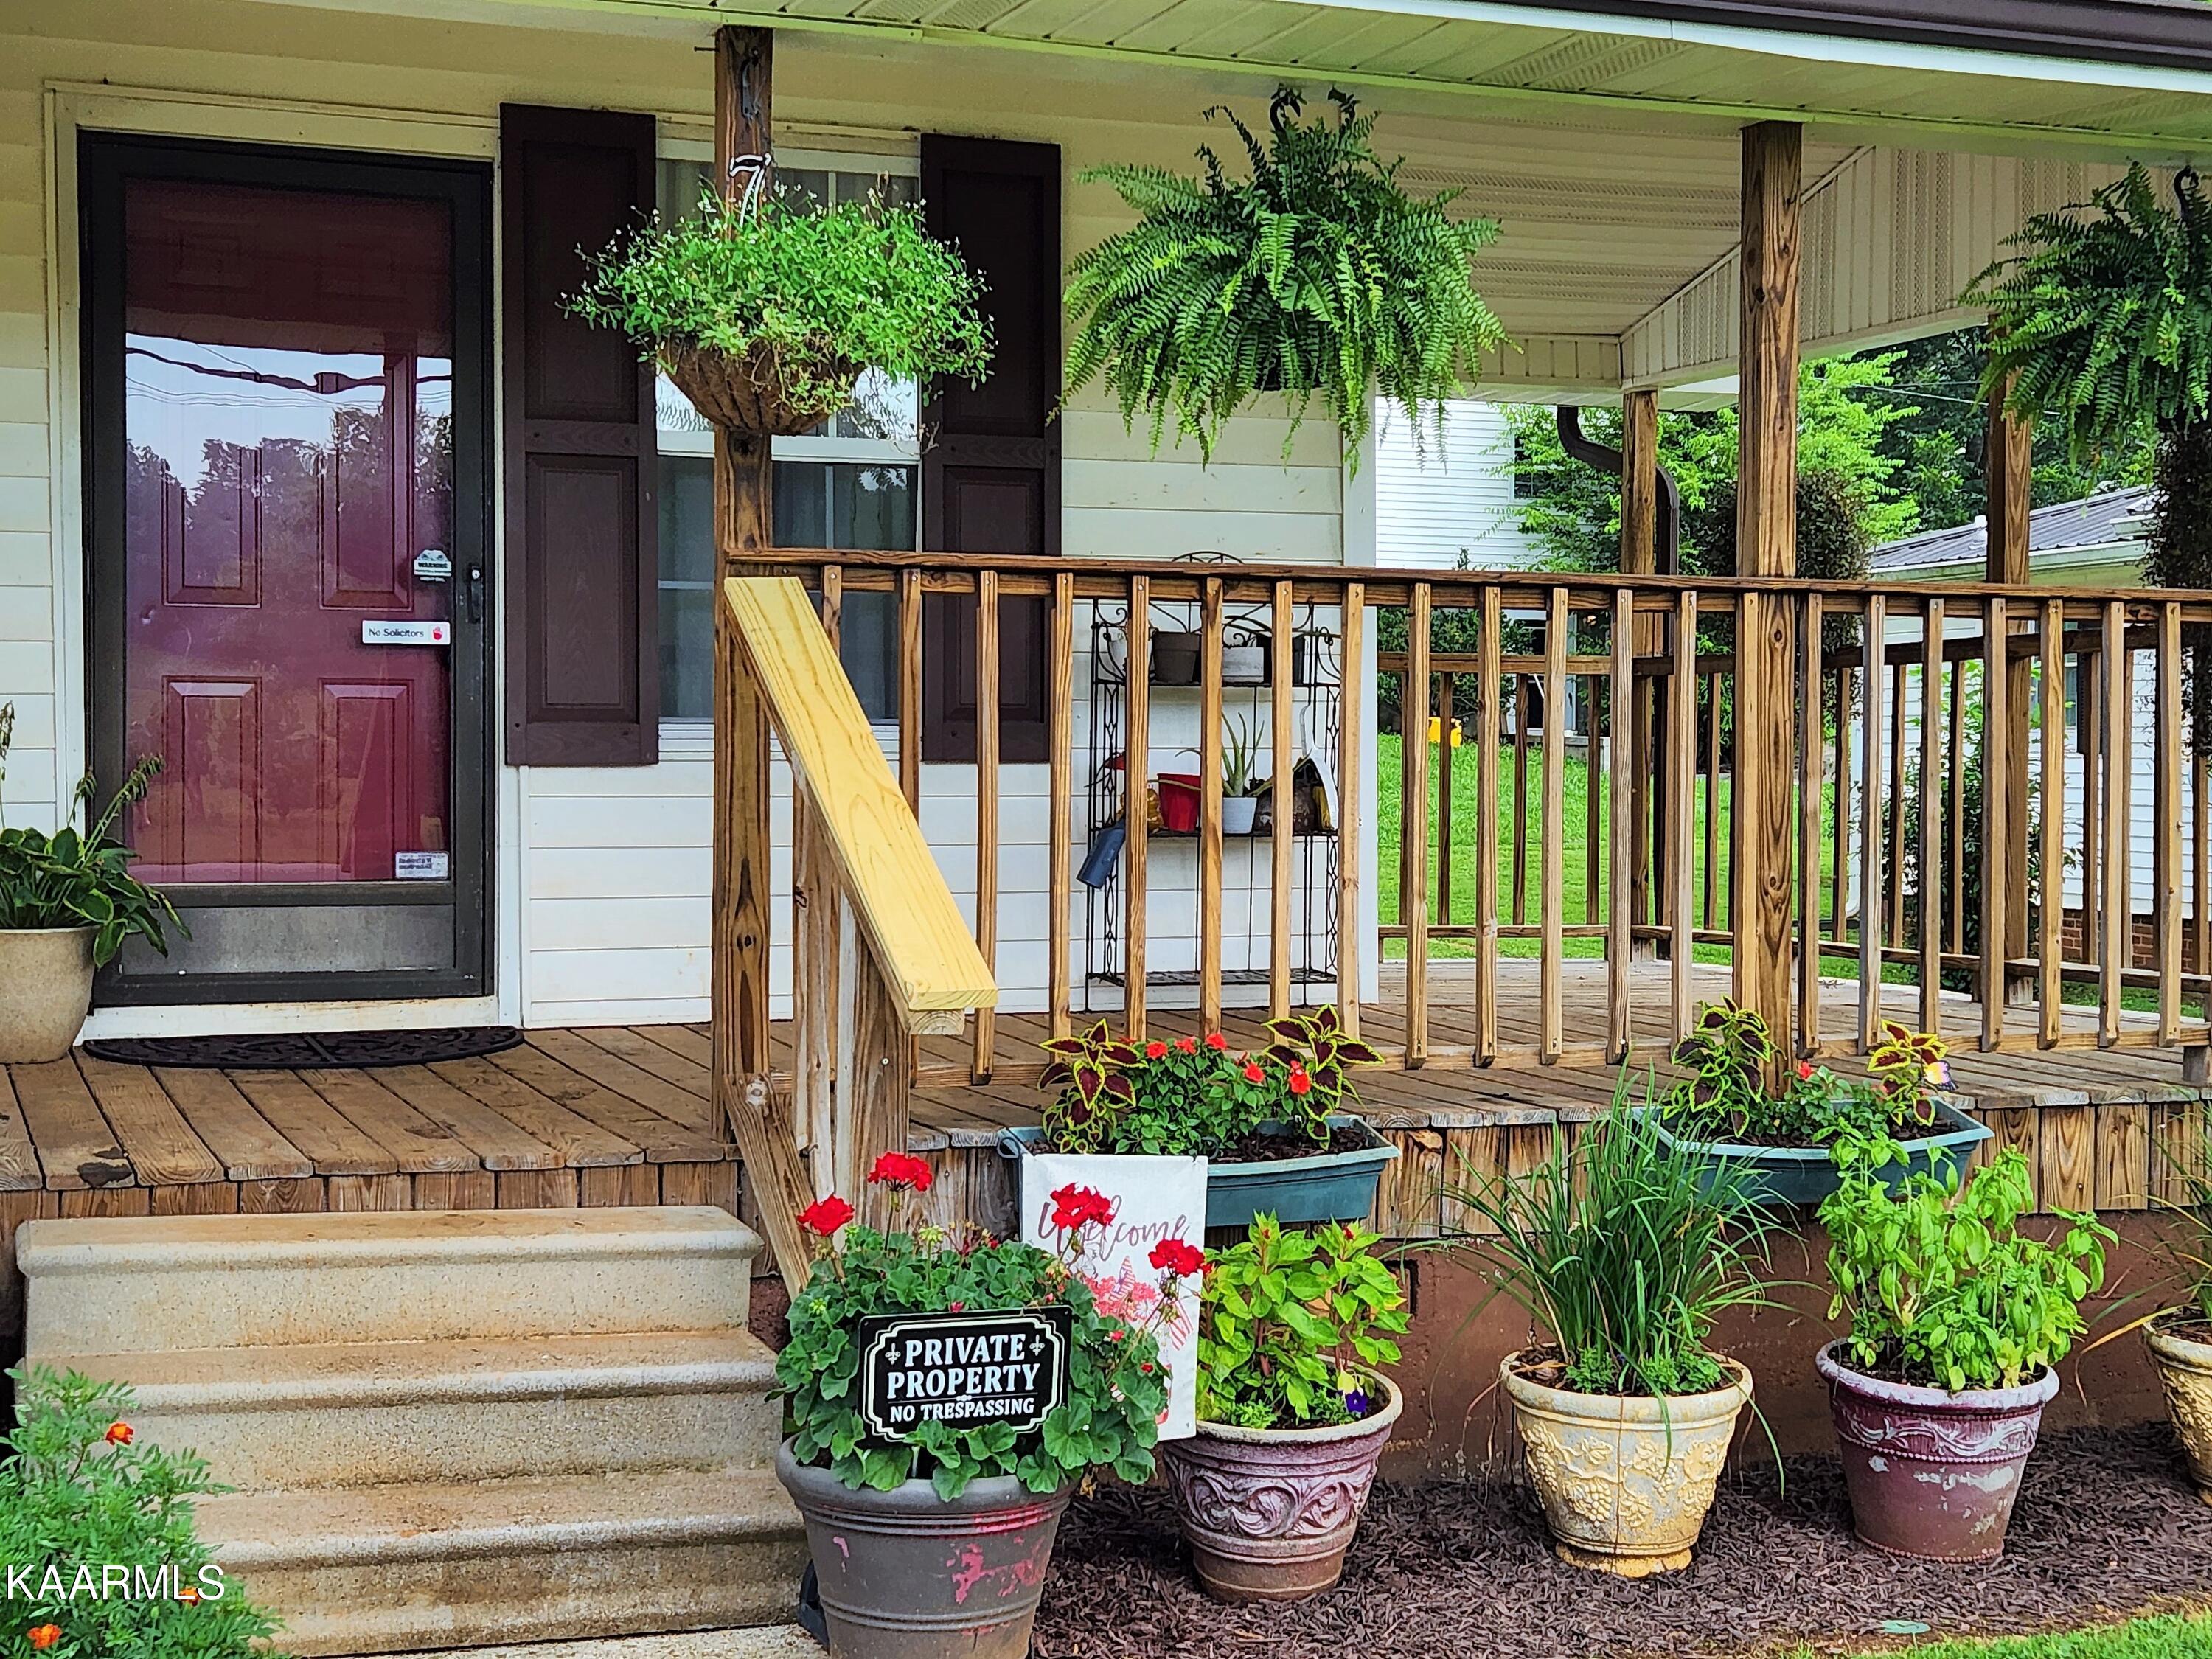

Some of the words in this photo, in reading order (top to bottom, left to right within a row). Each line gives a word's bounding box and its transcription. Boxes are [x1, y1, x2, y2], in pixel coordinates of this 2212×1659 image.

[369, 628, 380, 637] No
[383, 628, 424, 638] Solicitors
[905, 1333, 1026, 1367] PRIVATE
[887, 1363, 1040, 1399] PROPERTY
[890, 1404, 916, 1422] NO
[920, 1398, 1034, 1420] TRESPASSING
